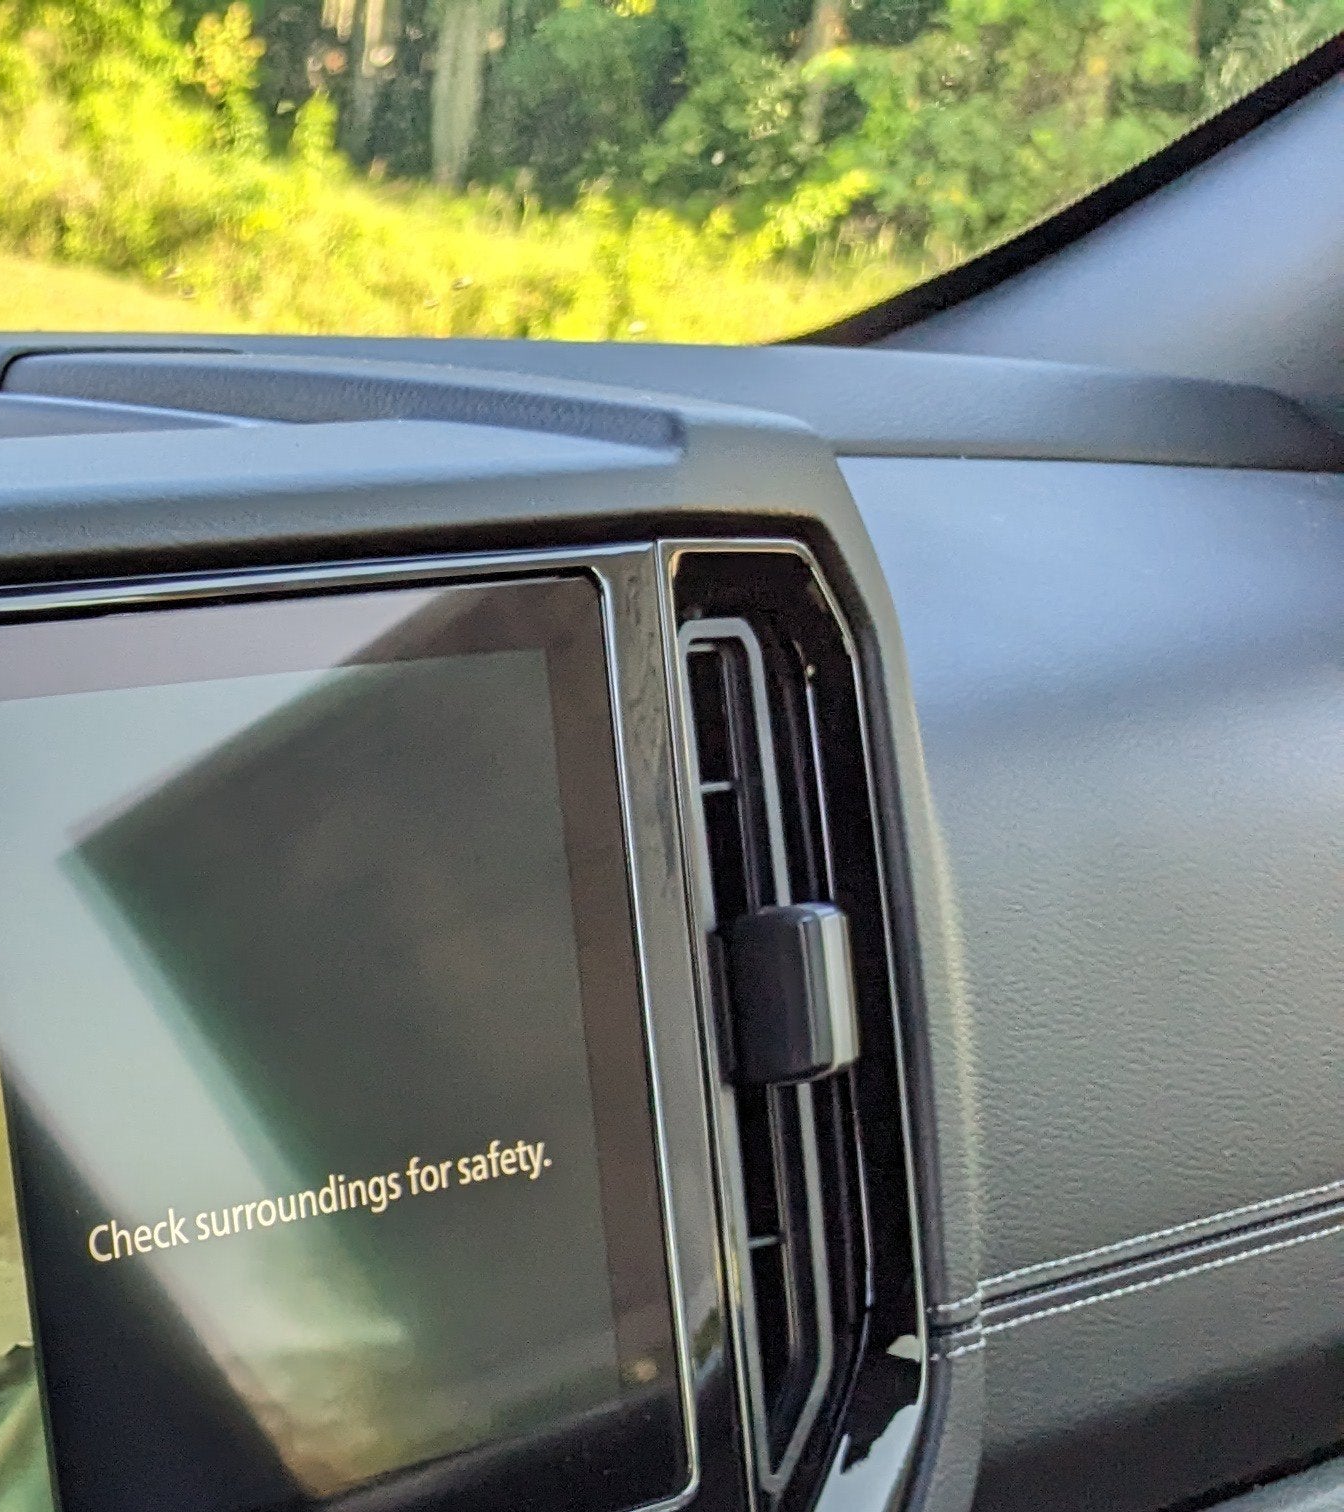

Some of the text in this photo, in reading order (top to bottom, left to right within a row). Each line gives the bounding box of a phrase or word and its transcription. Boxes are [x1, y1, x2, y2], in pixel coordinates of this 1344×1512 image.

[88, 1138, 553, 1264] Check surroundings for safety.
